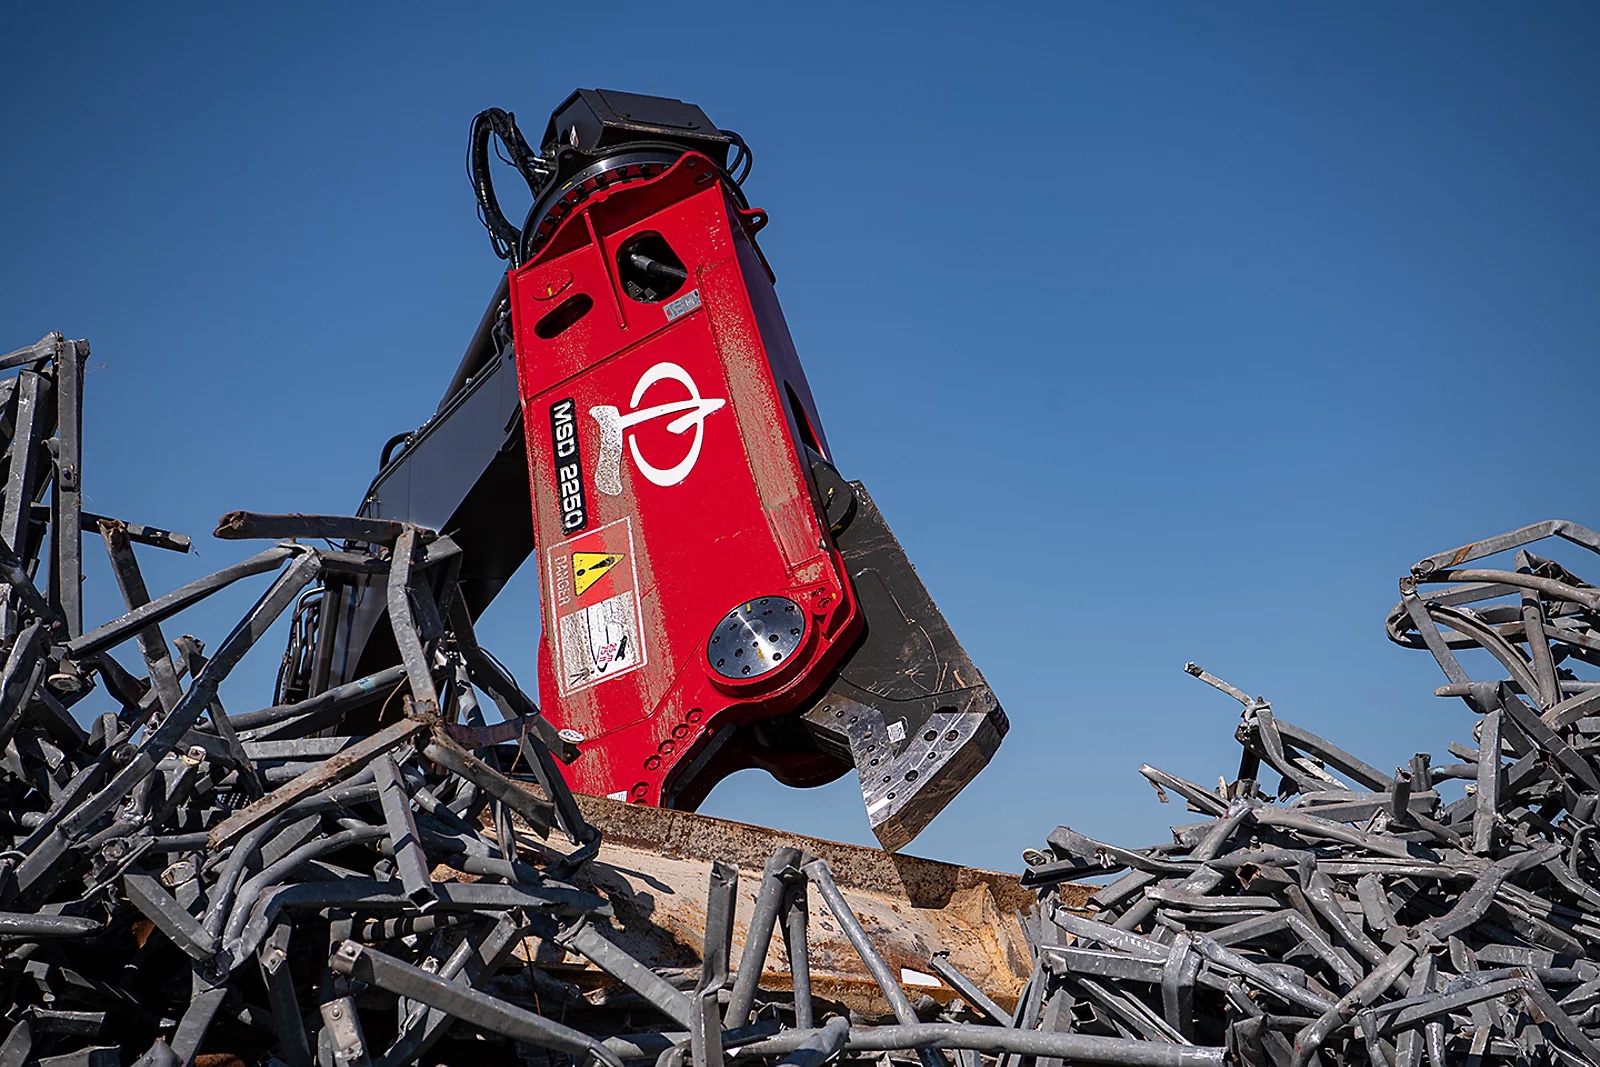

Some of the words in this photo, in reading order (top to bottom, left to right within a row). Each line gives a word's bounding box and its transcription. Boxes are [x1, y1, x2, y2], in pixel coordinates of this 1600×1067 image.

[553, 401, 576, 458] MSD
[560, 463, 583, 529] 2250
[555, 555, 571, 607] DANGER
